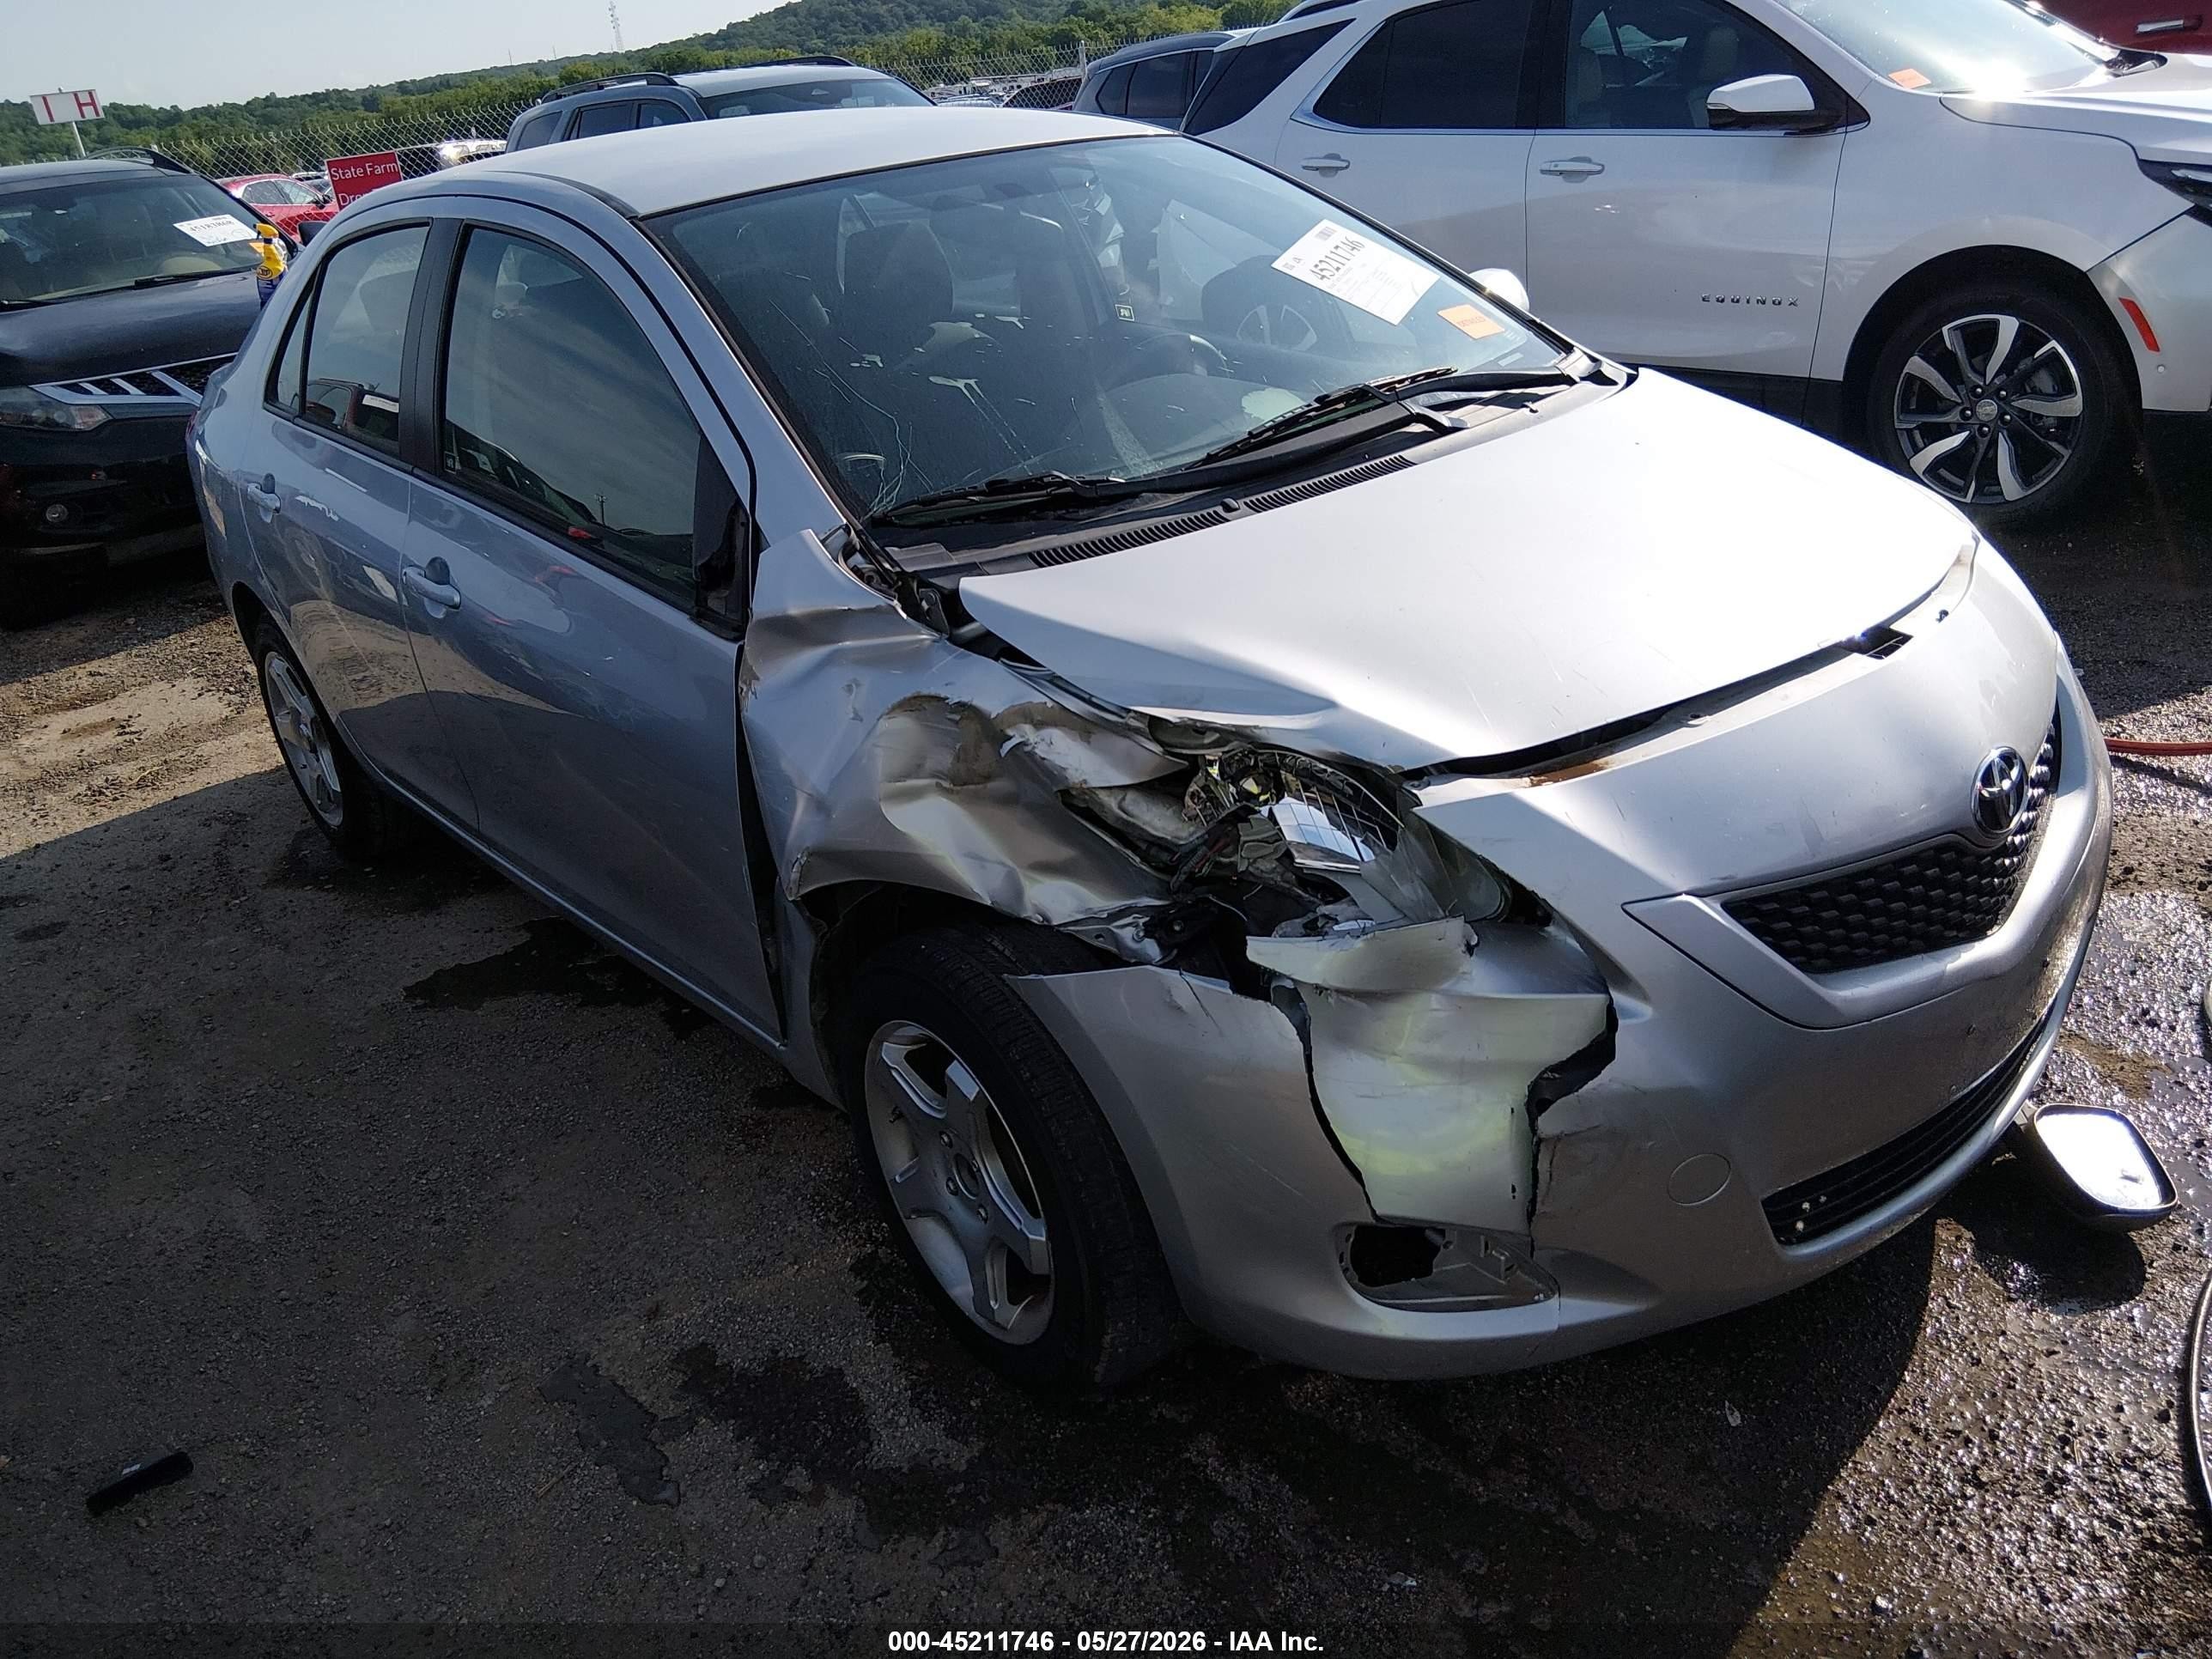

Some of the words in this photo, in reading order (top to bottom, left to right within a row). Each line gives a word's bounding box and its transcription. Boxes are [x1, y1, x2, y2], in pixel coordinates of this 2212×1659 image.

[331, 166, 364, 180] State
[365, 162, 398, 176] Farm
[1309, 235, 1365, 280] 45211746
[1701, 293, 1799, 307] EQUINOX
